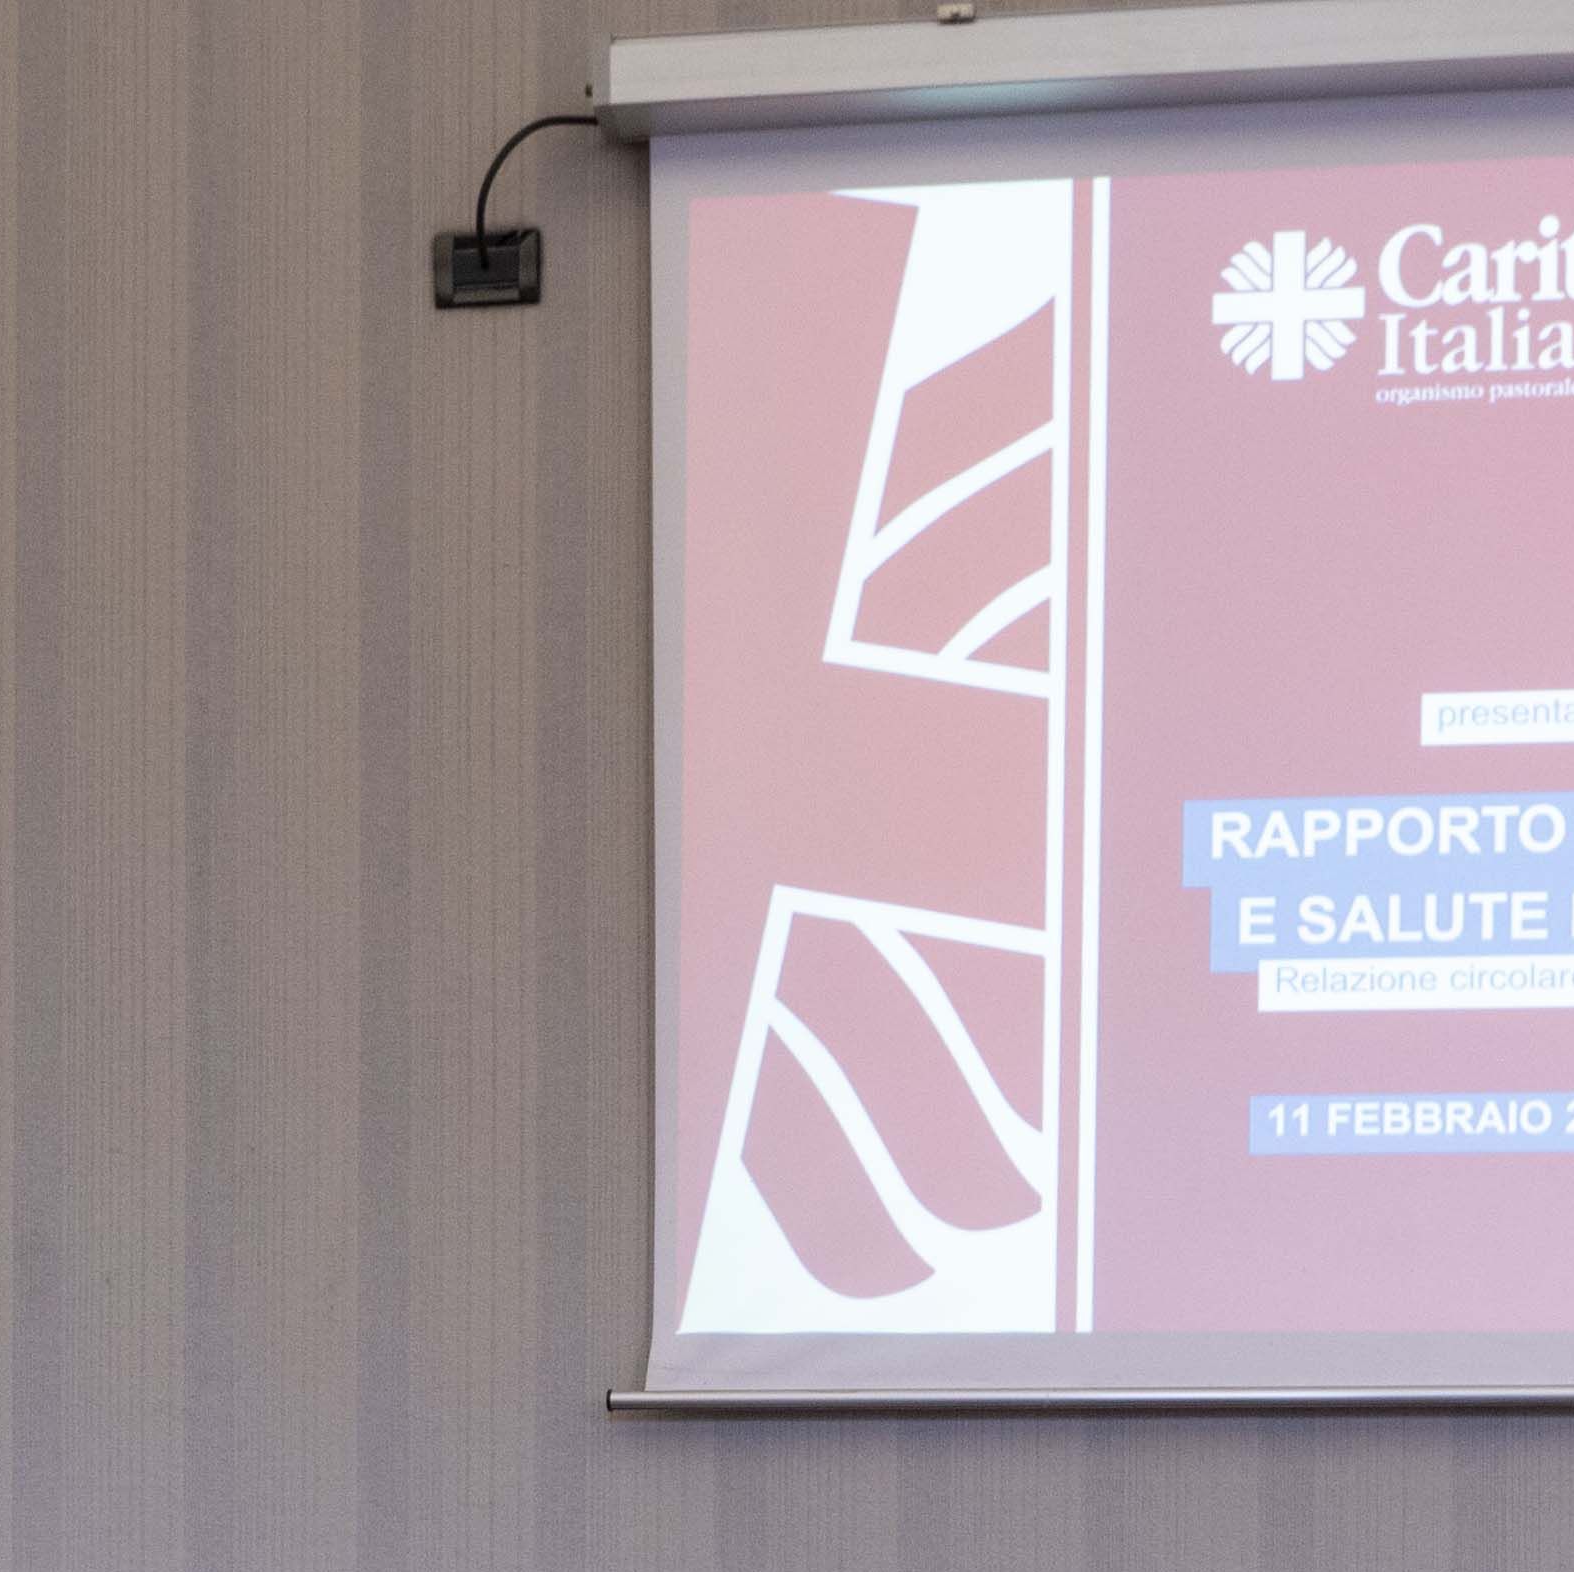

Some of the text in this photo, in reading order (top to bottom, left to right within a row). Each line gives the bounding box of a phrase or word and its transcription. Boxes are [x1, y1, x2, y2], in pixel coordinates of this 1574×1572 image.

[1375, 382, 1484, 405] organismo
[1210, 804, 1567, 859] RAPPORTO
[1238, 896, 1277, 945] E
[1296, 890, 1549, 944] SALUTE
[1275, 966, 1438, 993] Relazione
[1267, 1105, 1311, 1137] 11
[1327, 1101, 1553, 1137] FEBBRAIO
